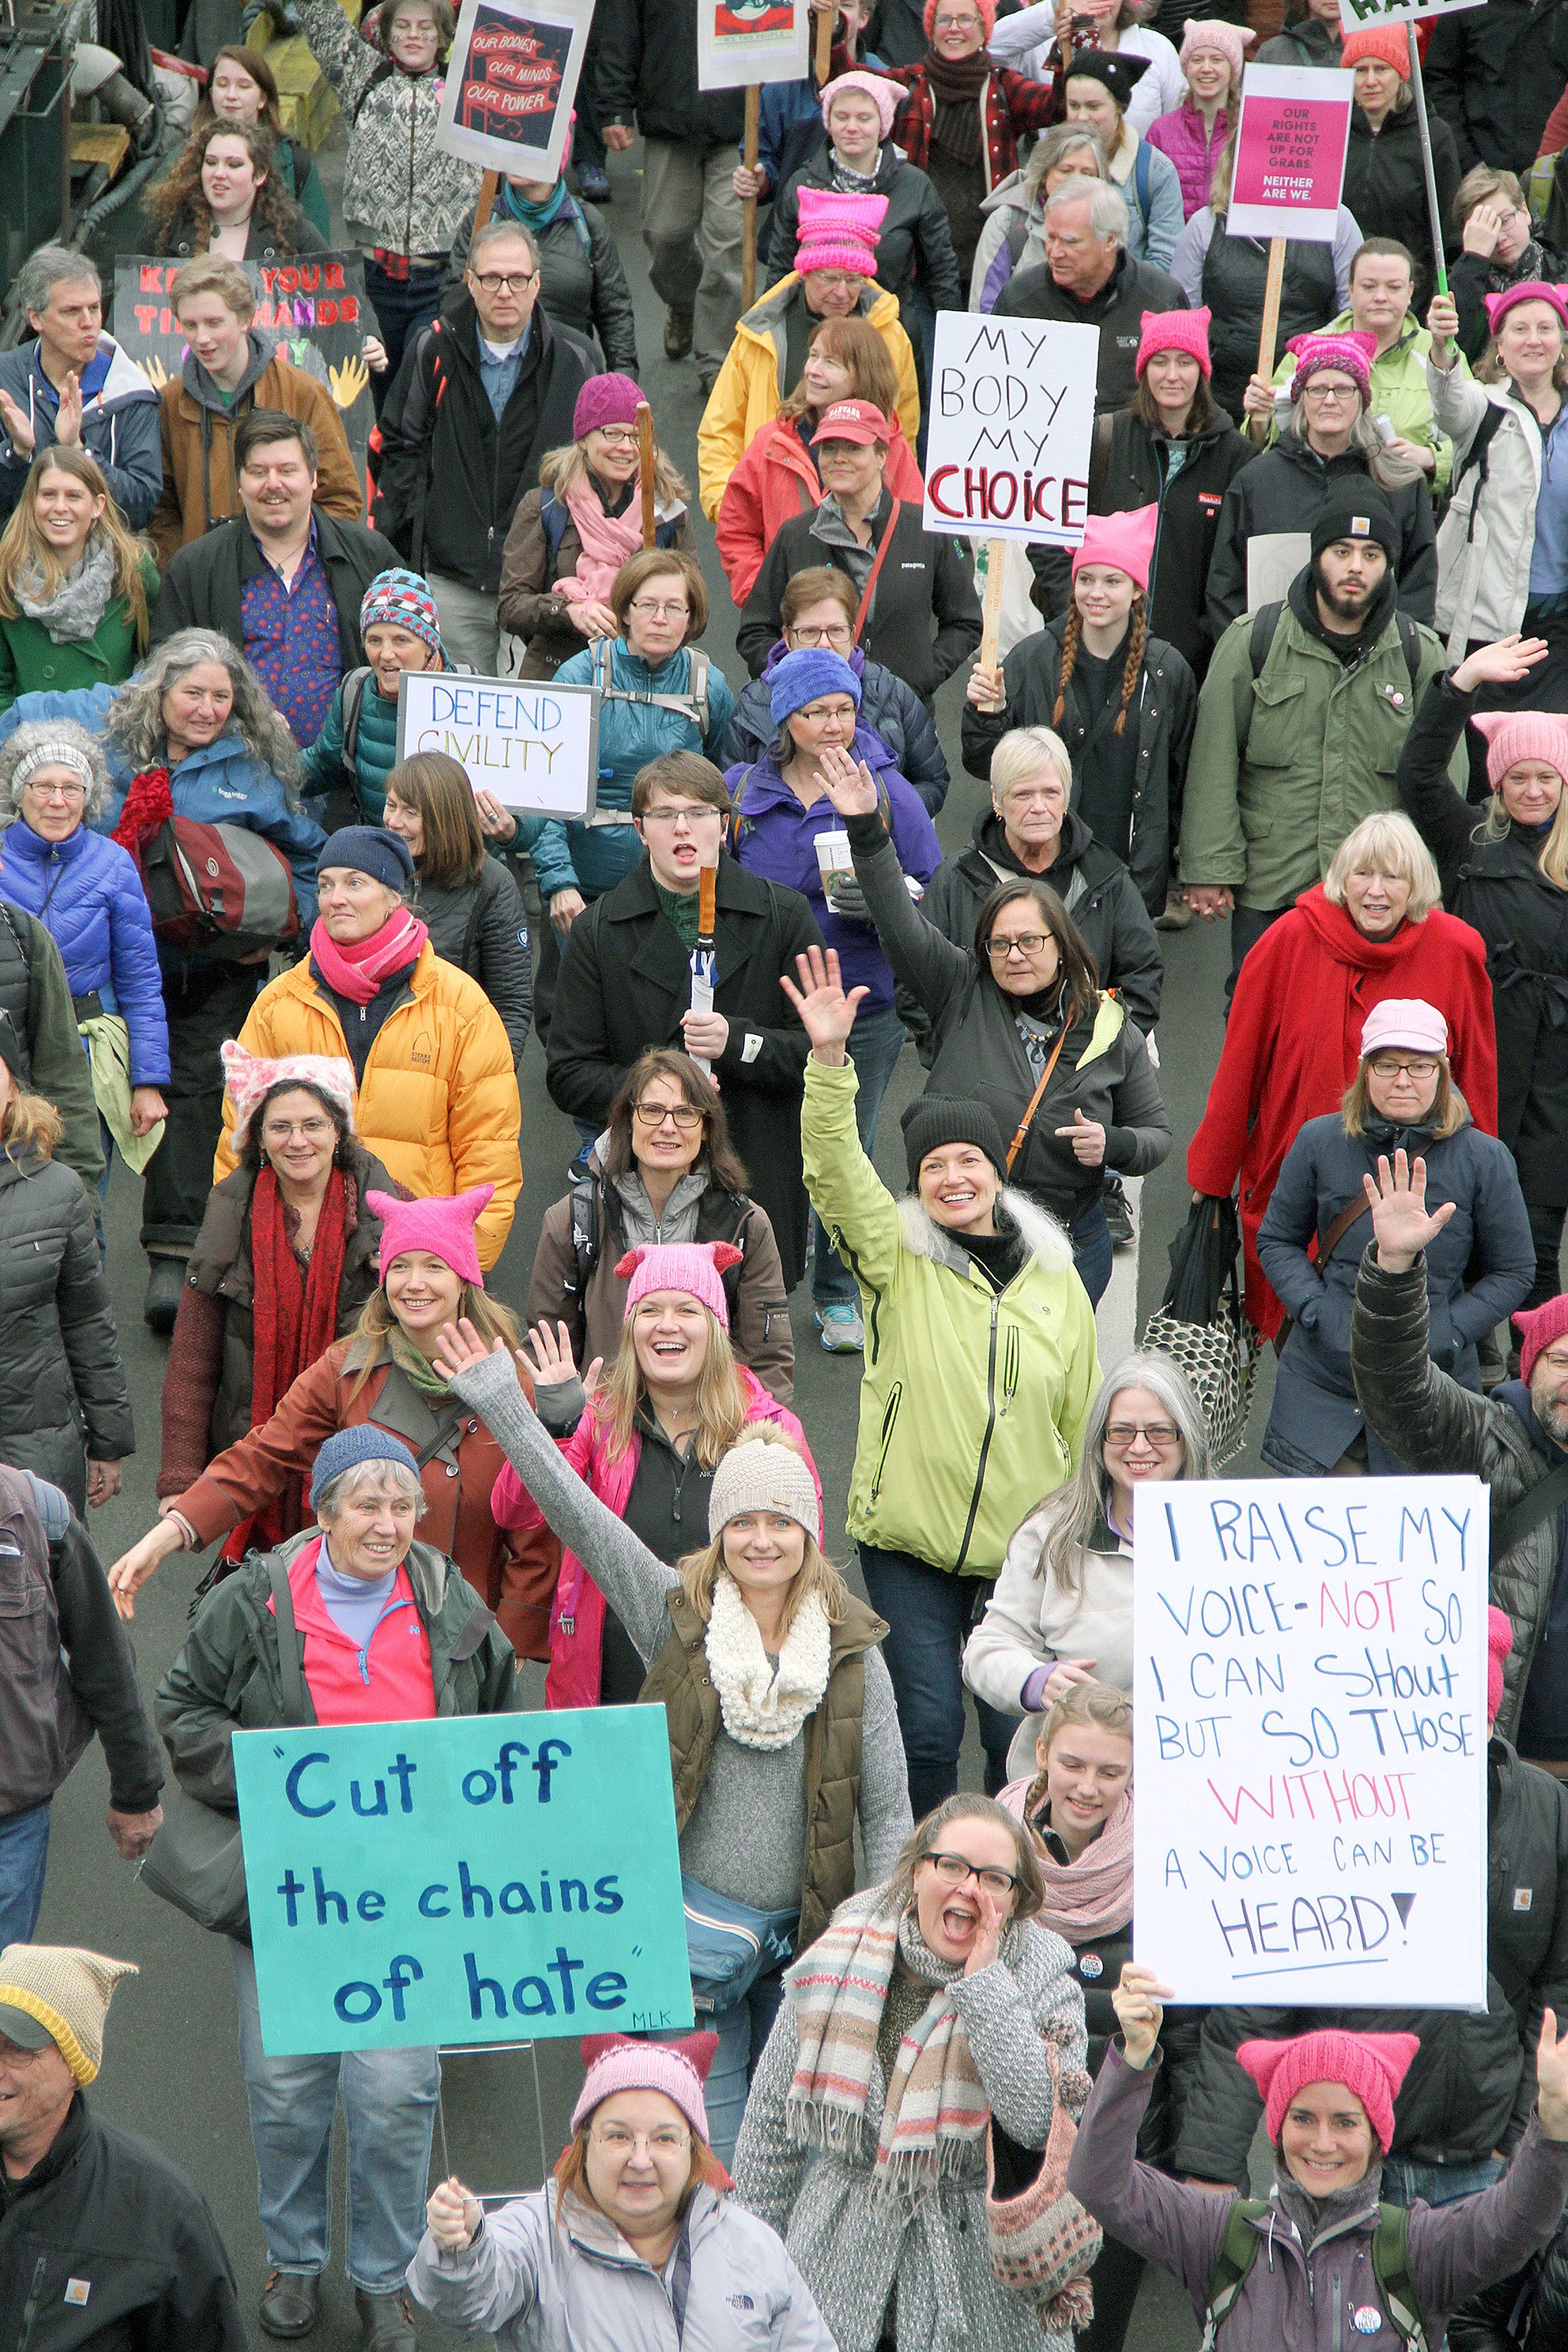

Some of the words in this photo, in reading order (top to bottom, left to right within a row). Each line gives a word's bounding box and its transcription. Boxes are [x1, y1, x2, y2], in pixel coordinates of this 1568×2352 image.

[472, 37, 498, 48] OUR
[498, 35, 537, 52] BODIES
[488, 61, 515, 76] OUR
[516, 67, 552, 81] MINDS
[466, 85, 499, 104] OUR
[501, 93, 545, 111] POWER
[1283, 108, 1309, 119] OUR
[1267, 133, 1290, 142] ARE
[1294, 134, 1321, 145] NOT
[1272, 120, 1317, 131] RIGHTS
[1269, 145, 1285, 154] UP
[1289, 146, 1313, 156] FOR
[1263, 175, 1313, 188] NEITHER
[1263, 188, 1286, 199] ARE
[1290, 190, 1312, 201] WE.
[260, 263, 345, 294] YOUR
[252, 296, 359, 328] HANDS
[965, 325, 1047, 369] MY
[828, 406, 861, 419] HARVARD
[941, 368, 1068, 426] BODY
[967, 426, 1049, 467] MY
[995, 546, 1004, 572] DEPOT
[432, 686, 562, 732] DEFEND
[418, 730, 564, 775] CIVILITY
[412, 1051, 431, 1060] SIERRA
[1165, 1502, 1181, 1562] I
[1210, 1499, 1377, 1567] RAISE
[1399, 1506, 1472, 1571] MY
[1422, 1579, 1462, 1645] SO
[1150, 1655, 1165, 1702] I
[1191, 1652, 1285, 1699] CAN
[1155, 1714, 1232, 1760] BUT
[1261, 1707, 1340, 1767] SO
[1349, 1708, 1475, 1757] THOSE
[461, 1738, 573, 1805] off
[1207, 1769, 1416, 1825] WITHOUT
[1165, 1847, 1187, 1890] A
[1198, 1843, 1298, 1882] VOICE
[1332, 1835, 1392, 1872] CAN
[1410, 1832, 1447, 1866] BE
[276, 1866, 387, 1927] the
[417, 1860, 624, 1918] chains
[1210, 1892, 1417, 1958] HEARD!
[333, 1954, 424, 2024] of
[632, 2011, 671, 2030] MLK
[1357, 2320, 1377, 2328] HATE
